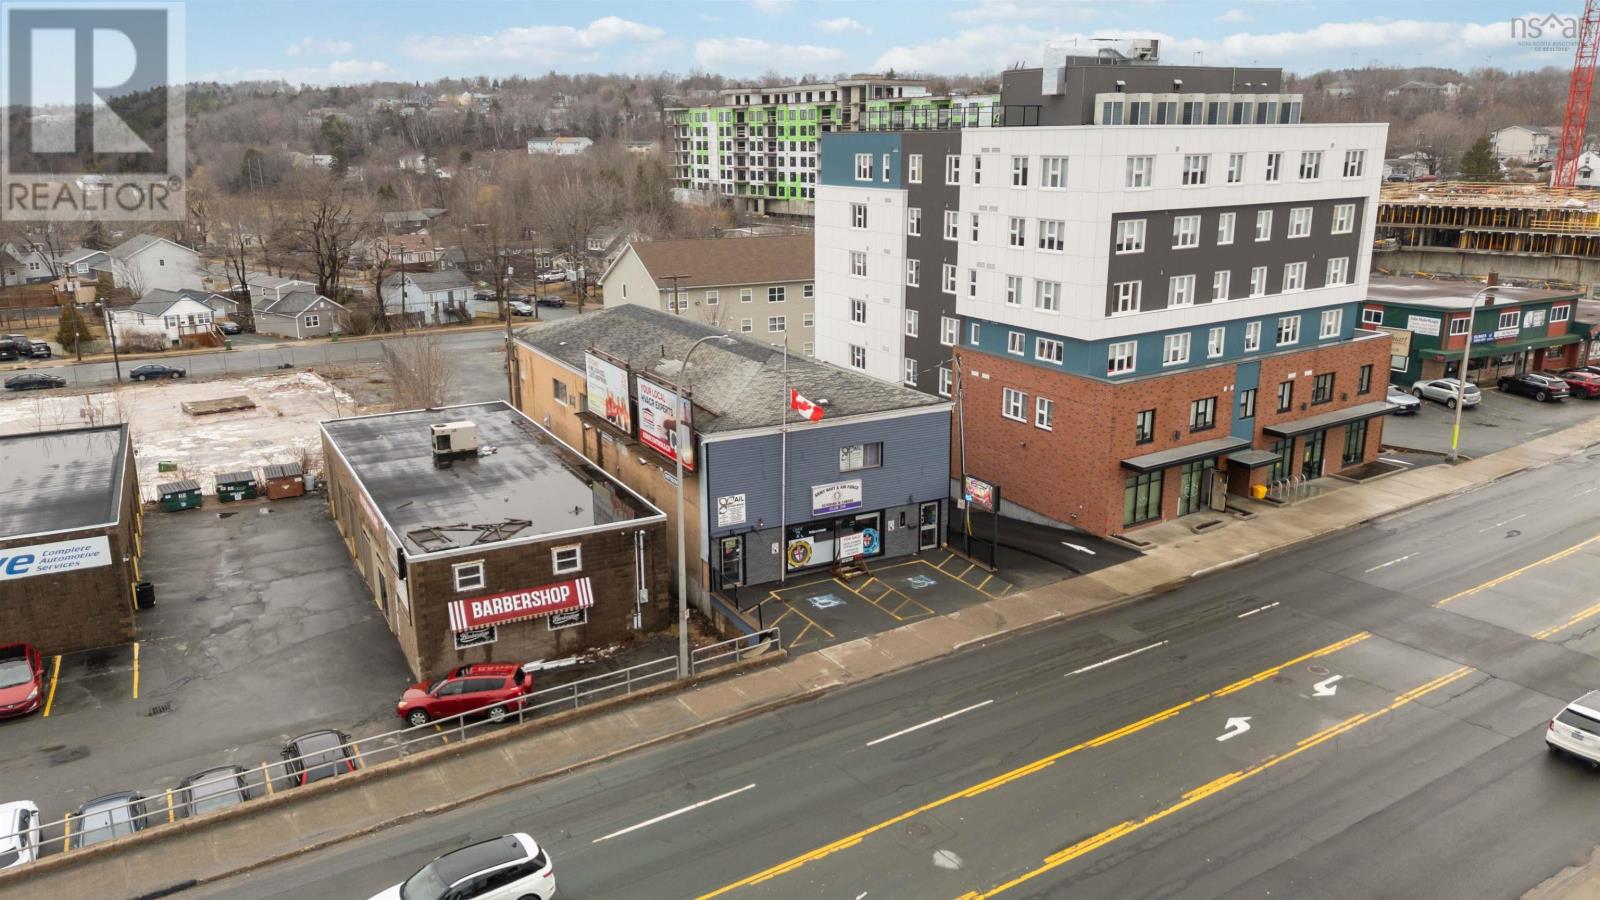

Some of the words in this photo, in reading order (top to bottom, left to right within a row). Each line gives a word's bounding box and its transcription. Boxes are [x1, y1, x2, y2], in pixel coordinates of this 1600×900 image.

[652, 389, 667, 403] LOCAL
[39, 551, 100, 564] Automotive
[42, 545, 92, 557] Complete
[36, 561, 80, 572] Services
[471, 585, 570, 619] BARBERSHOP
